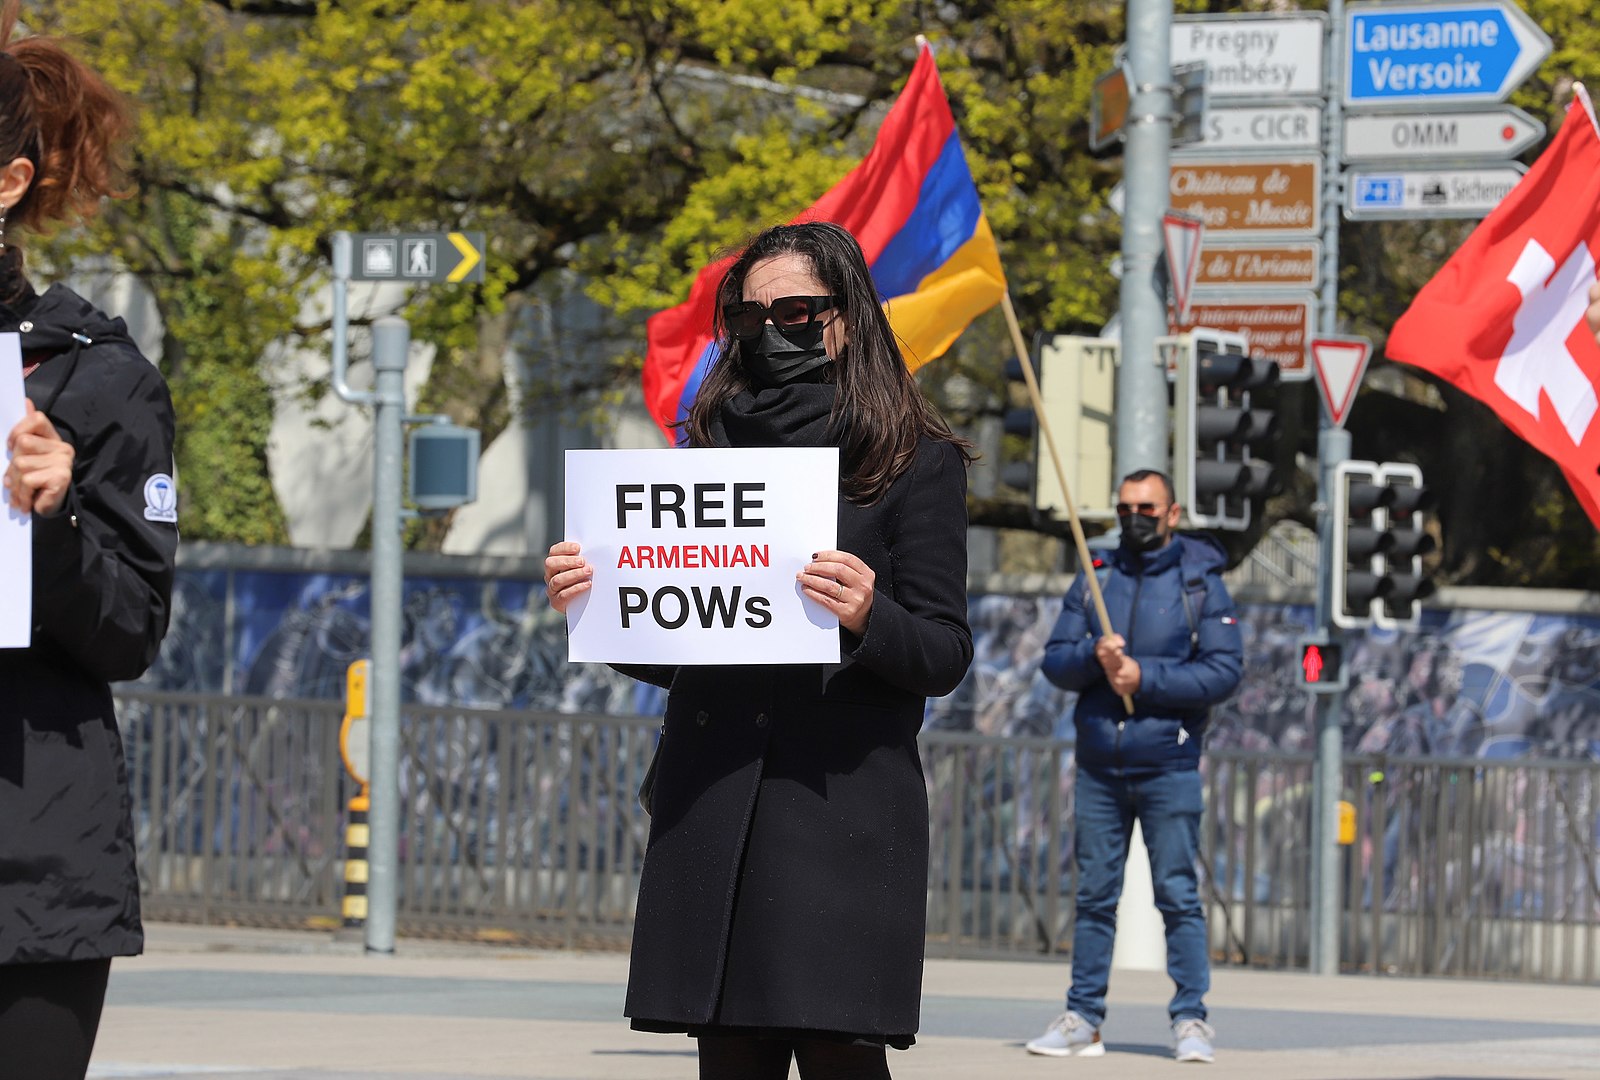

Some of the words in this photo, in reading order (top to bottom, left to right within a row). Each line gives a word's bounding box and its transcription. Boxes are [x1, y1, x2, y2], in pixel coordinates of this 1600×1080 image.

[1189, 25, 1279, 58] Pregny
[1355, 18, 1499, 52] Lausanne
[1368, 53, 1482, 91] Versoix
[1251, 114, 1309, 141] CICR
[1392, 122, 1458, 149] OMM
[1170, 169, 1257, 196] Château
[1262, 168, 1290, 195] de
[1245, 199, 1312, 225] Musée
[1207, 254, 1232, 278] de
[1200, 305, 1302, 325] international
[616, 482, 766, 529] FREE
[617, 544, 769, 568] ARMENIAN
[618, 585, 772, 630] POWs
